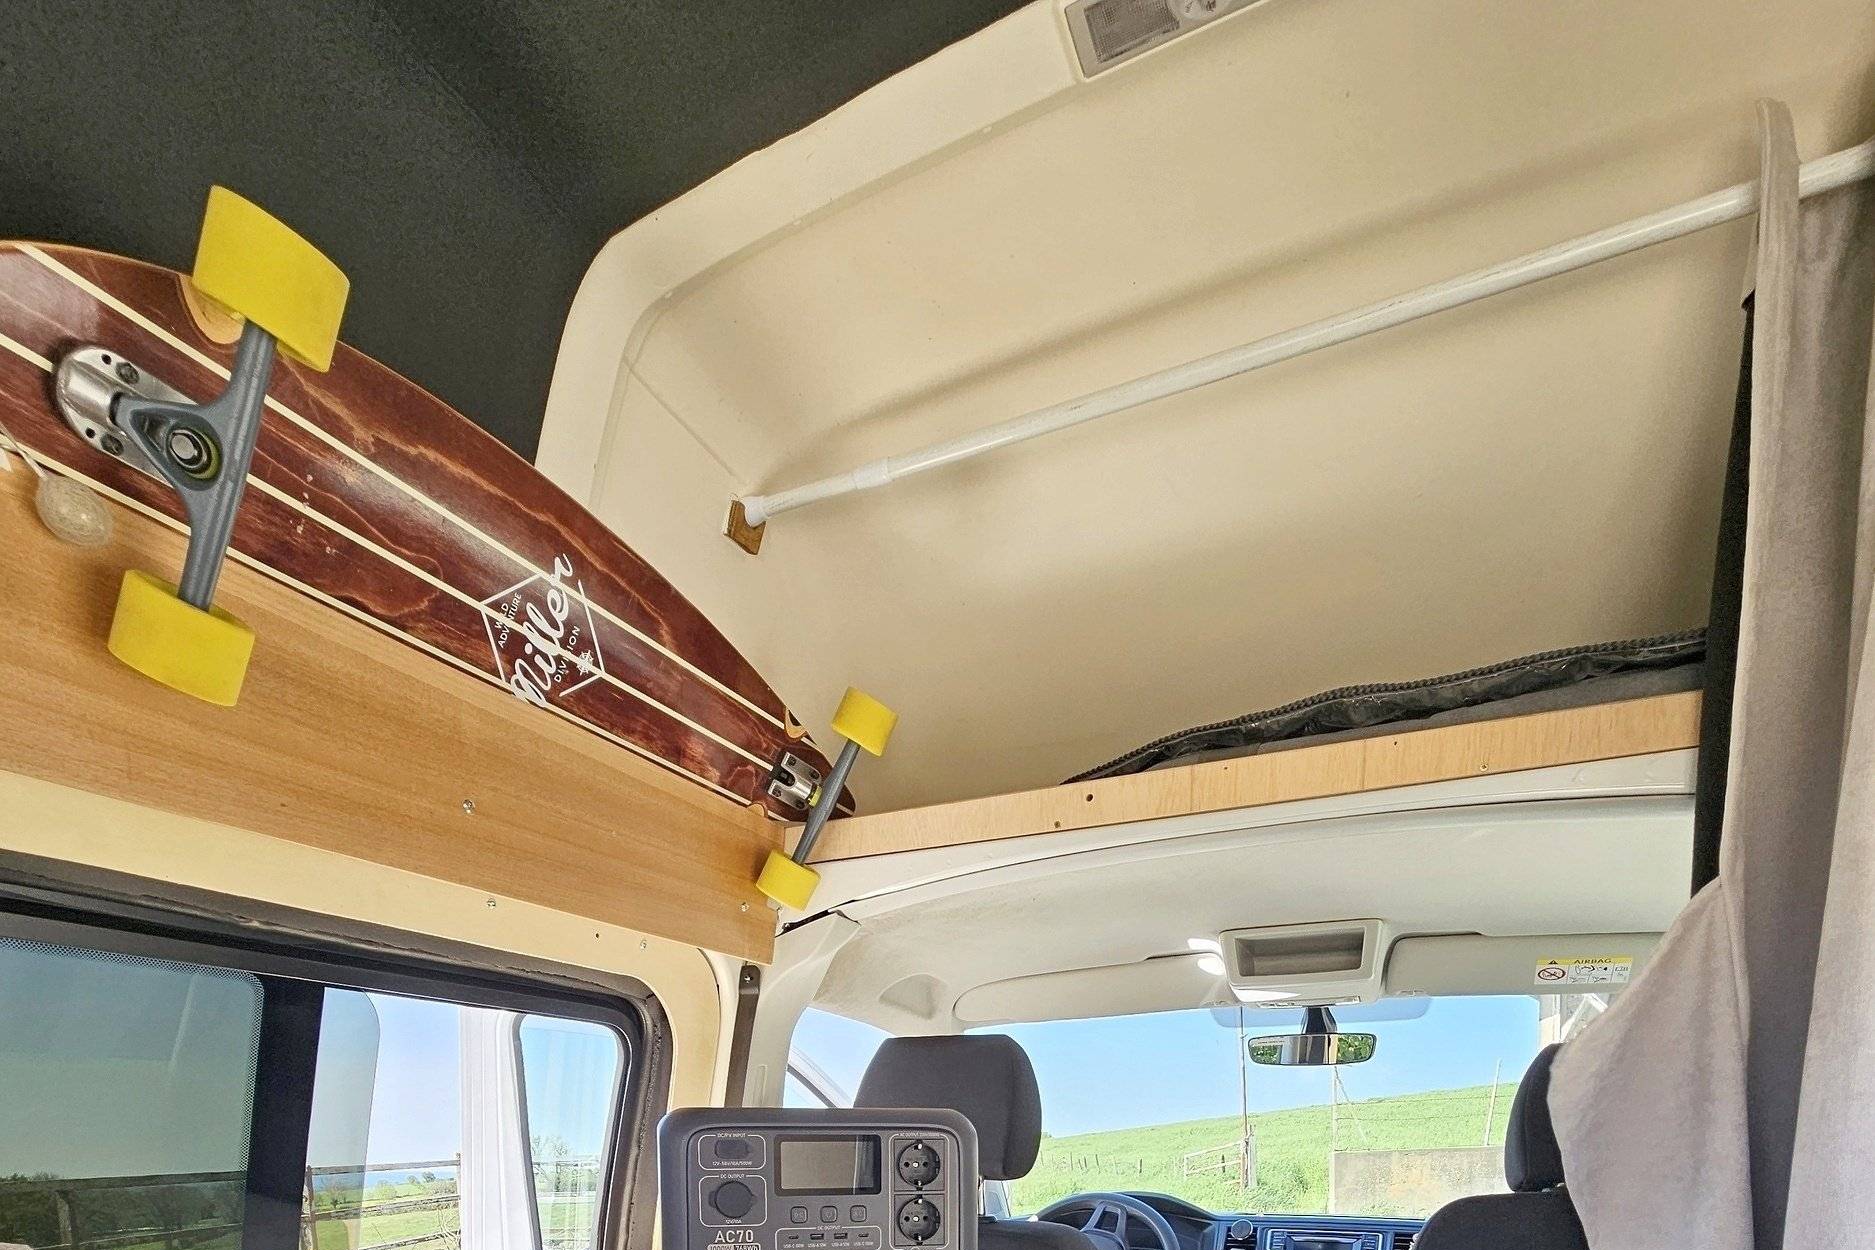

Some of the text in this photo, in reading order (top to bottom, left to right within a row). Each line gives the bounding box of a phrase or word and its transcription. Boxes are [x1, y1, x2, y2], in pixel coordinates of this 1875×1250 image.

[494, 602, 508, 630] WLD
[498, 592, 522, 648] ADVNTURE
[553, 625, 581, 683] DIVIION
[714, 1229, 754, 1244] AC70
